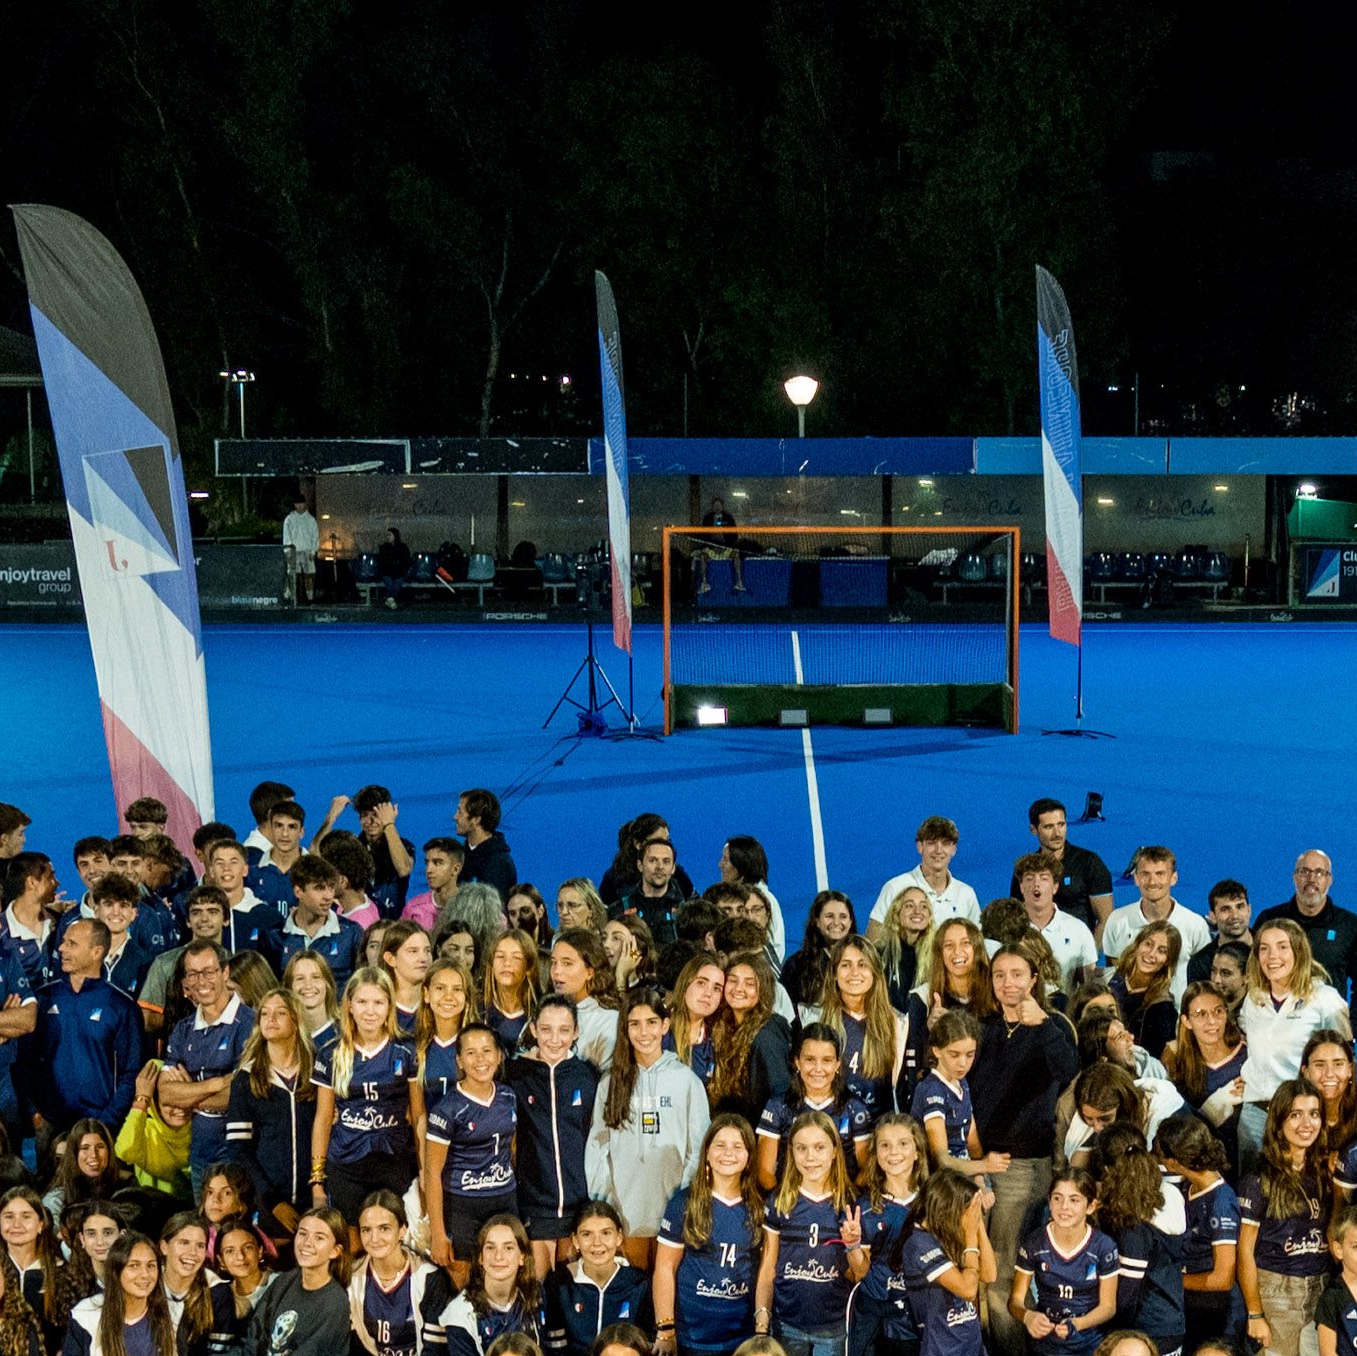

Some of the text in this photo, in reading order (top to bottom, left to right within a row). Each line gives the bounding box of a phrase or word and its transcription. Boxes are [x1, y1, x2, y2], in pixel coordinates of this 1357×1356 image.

[1181, 498, 1216, 517] Cuba
[38, 581, 72, 594] group
[485, 612, 547, 620] PORSCHE
[848, 1052, 860, 1074] 4
[363, 1082, 378, 1100] 15
[440, 1077, 446, 1096] 7
[342, 1109, 373, 1130] Enjoy
[462, 1169, 496, 1187] Enjoy
[809, 1222, 819, 1248] 3
[1284, 1237, 1320, 1253] Enjoy
[720, 1242, 736, 1268] 74
[784, 1262, 839, 1278] Enjoy Cuba
[696, 1280, 728, 1294] Enjoy
[377, 1320, 390, 1343] 16
